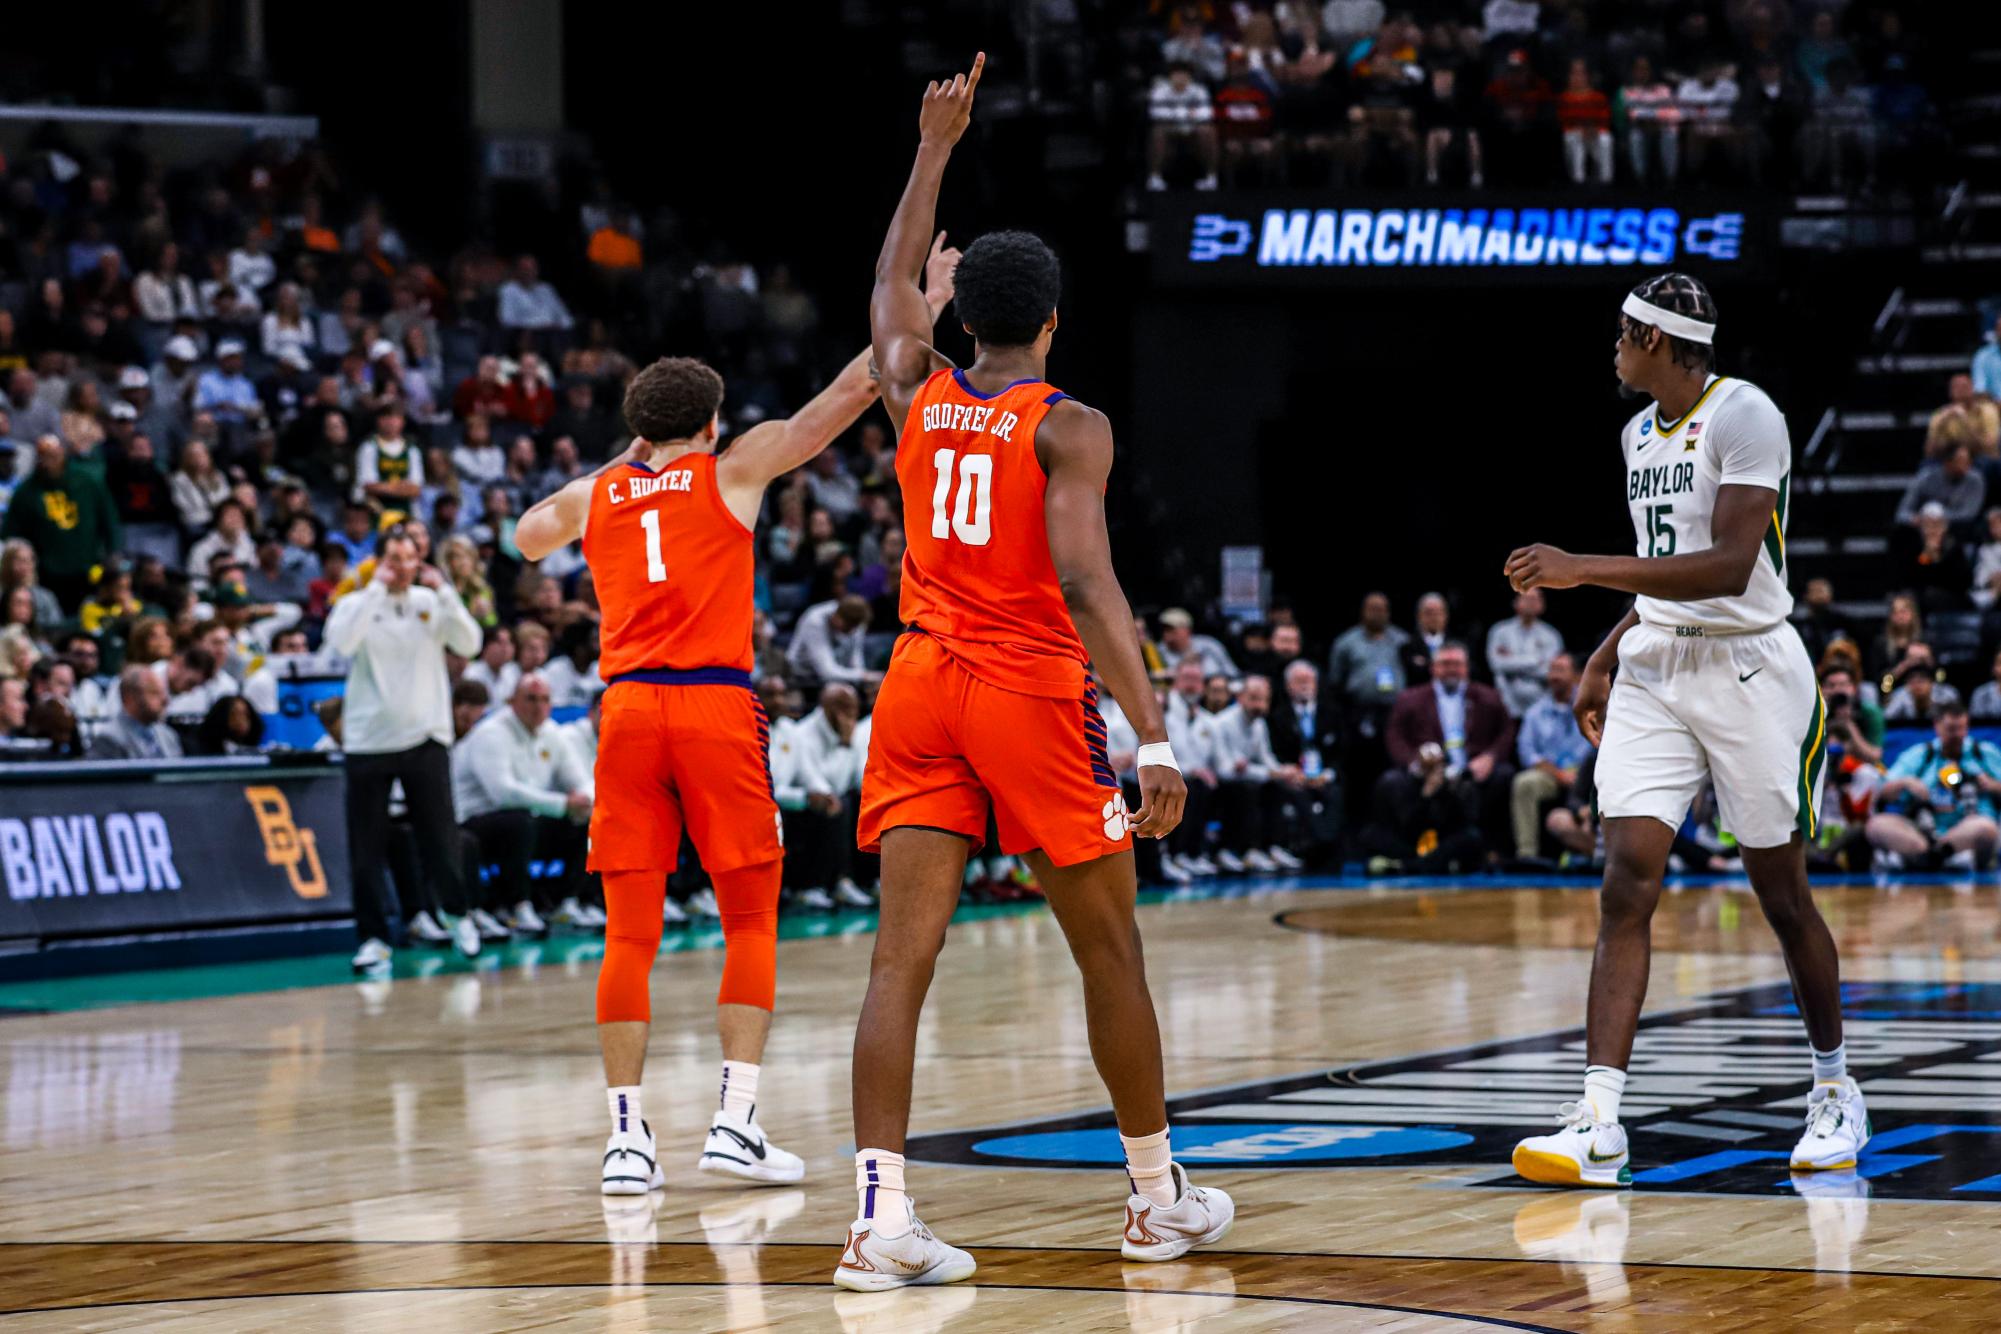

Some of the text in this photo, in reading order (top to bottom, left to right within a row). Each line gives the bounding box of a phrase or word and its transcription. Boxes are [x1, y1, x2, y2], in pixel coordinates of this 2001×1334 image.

[922, 402, 1019, 442] GODFREY JR
[608, 469, 693, 505] C. HUNTER
[931, 447, 993, 546] 10
[1629, 461, 1694, 501] BAYLOR
[640, 509, 668, 583] 1
[1646, 504, 1676, 558] 15
[1675, 625, 1704, 638] BEARS
[0, 811, 181, 900] BAYLOR
[243, 785, 329, 899] BU
